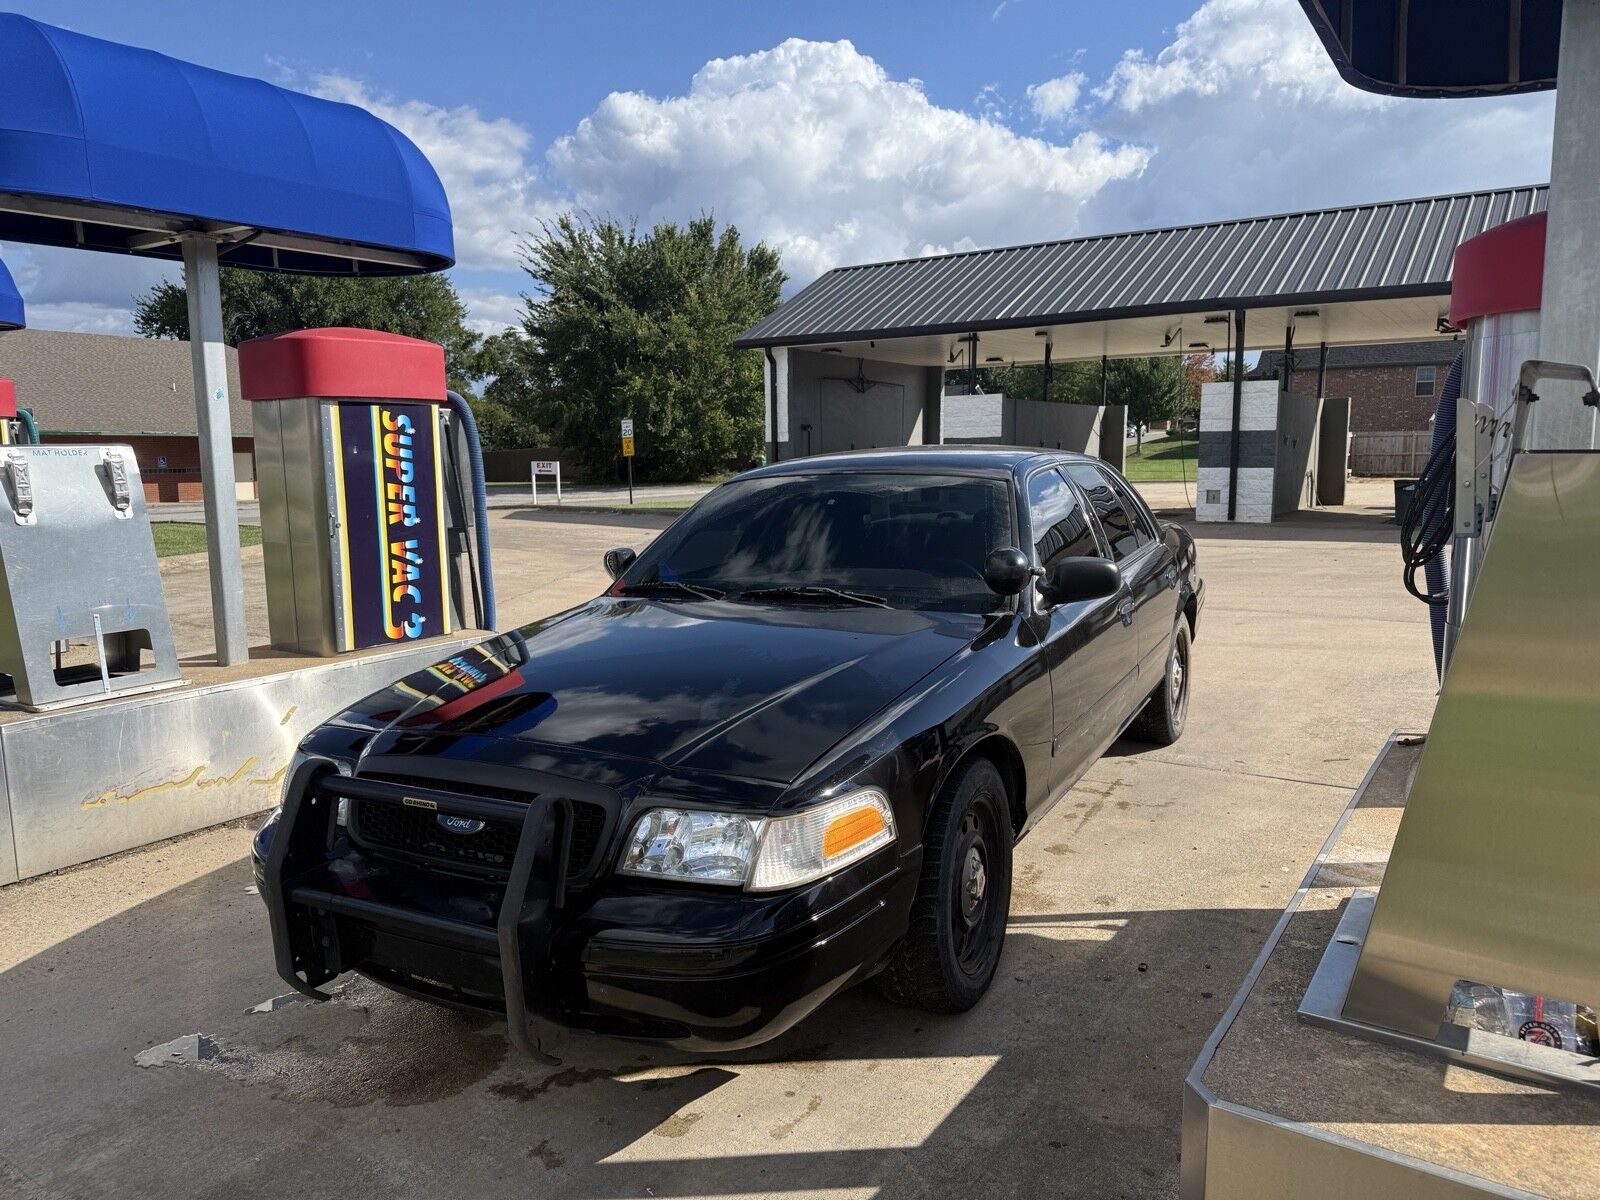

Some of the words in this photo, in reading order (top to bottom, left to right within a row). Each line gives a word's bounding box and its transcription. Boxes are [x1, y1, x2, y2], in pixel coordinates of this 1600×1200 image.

[382, 410, 420, 527] SUPER
[389, 539, 423, 604] VAC
[446, 816, 472, 828] Ford
